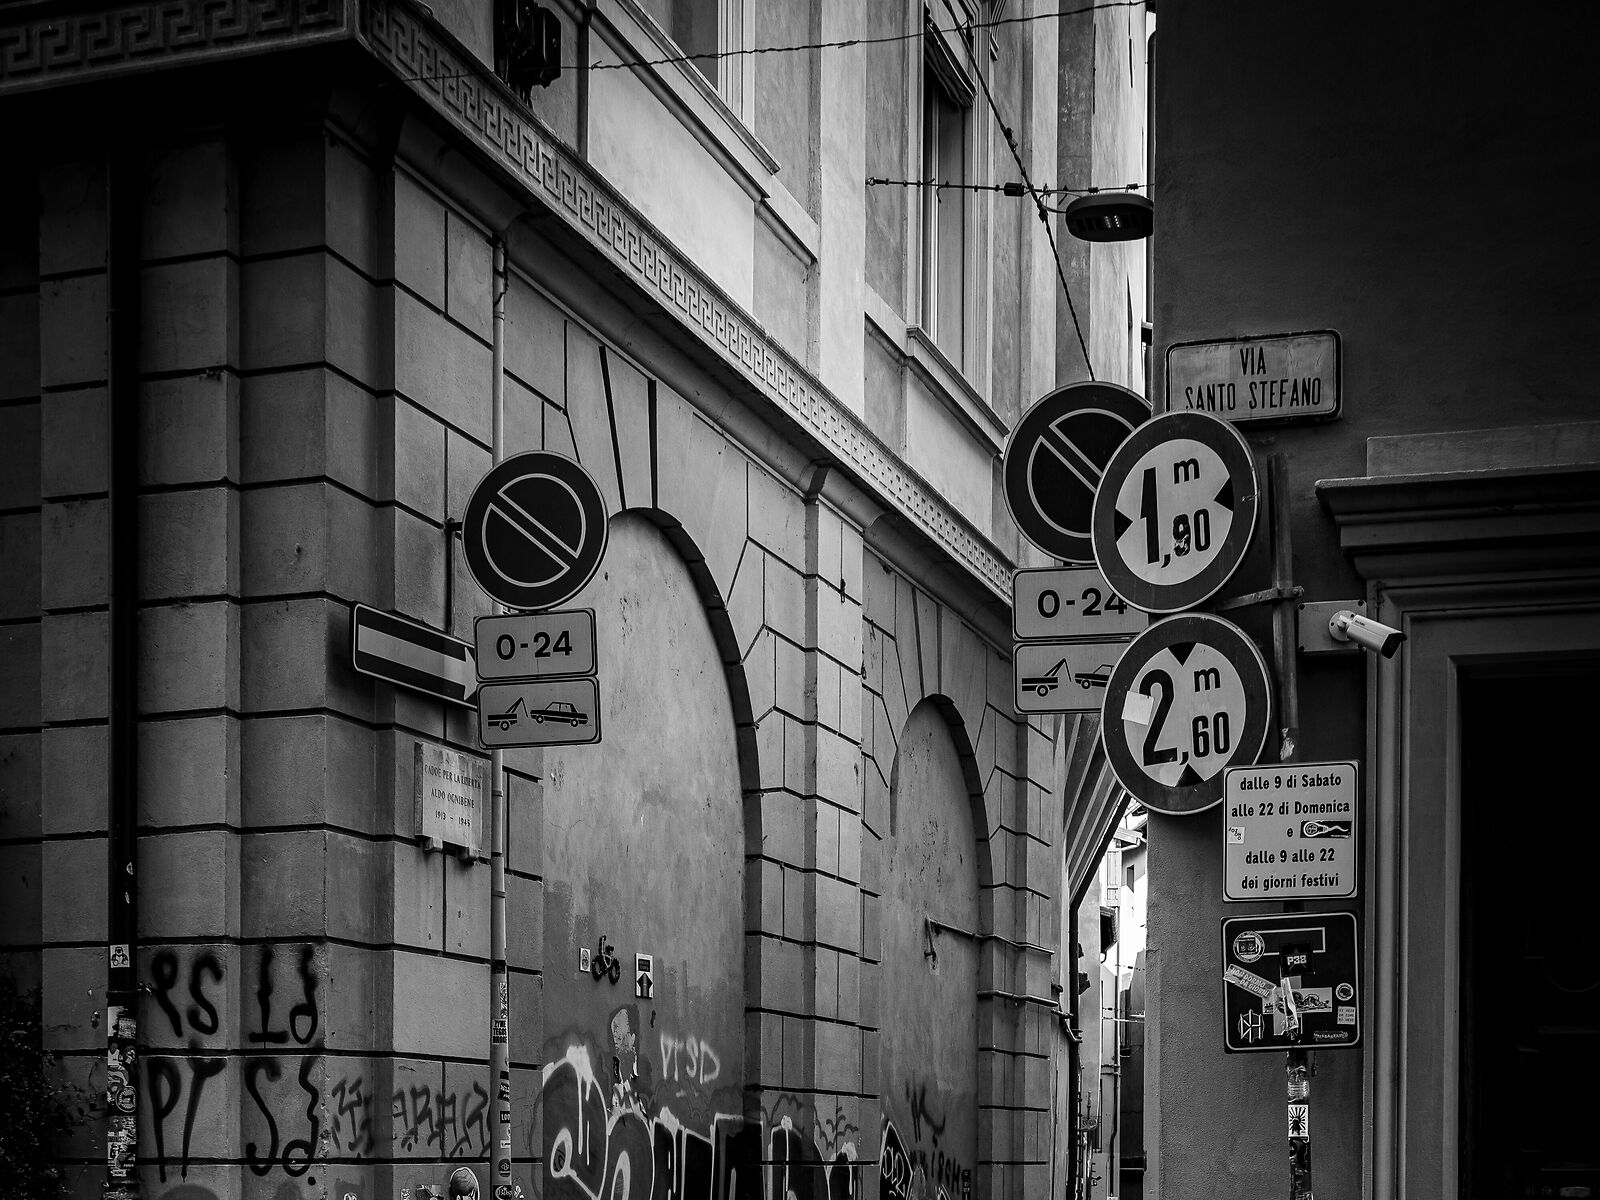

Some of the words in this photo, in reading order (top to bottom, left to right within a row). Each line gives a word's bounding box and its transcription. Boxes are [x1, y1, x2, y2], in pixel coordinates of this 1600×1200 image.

[1239, 346, 1267, 376] VIA
[1185, 382, 1236, 412] SANTO
[1248, 377, 1321, 409] STEFANO
[1173, 457, 1200, 485] m
[1140, 466, 1211, 569] 1,90
[1037, 587, 1128, 618] 0-24
[496, 630, 573, 660] 0-24
[1193, 667, 1221, 693] m
[1138, 668, 1230, 767] 2,60
[443, 769, 453, 781] PER
[454, 773, 461, 784] LA
[1240, 777, 1270, 790] dalle
[1274, 775, 1282, 789] 9
[1286, 775, 1297, 788] di
[1301, 773, 1342, 787] Sabato
[431, 787, 446, 800] ALDO
[1231, 804, 1254, 817] alle
[1259, 803, 1274, 816] 22
[1278, 802, 1289, 815] di
[1294, 800, 1350, 814] Domenica
[458, 816, 471, 827] 1945
[1286, 828, 1294, 838] e
[1245, 850, 1275, 864] dalle
[1280, 849, 1287, 863] 9
[1291, 849, 1315, 863] alle
[1320, 848, 1335, 861] 22
[1241, 876, 1258, 889] dei
[1263, 874, 1297, 891] giorni
[1301, 873, 1339, 887] festivi
[1286, 954, 1307, 966] P38
[1230, 967, 1245, 977] NON
[1243, 973, 1266, 988] DORMO
[1239, 979, 1249, 987] DA
[1248, 983, 1270, 997] GIORNI
